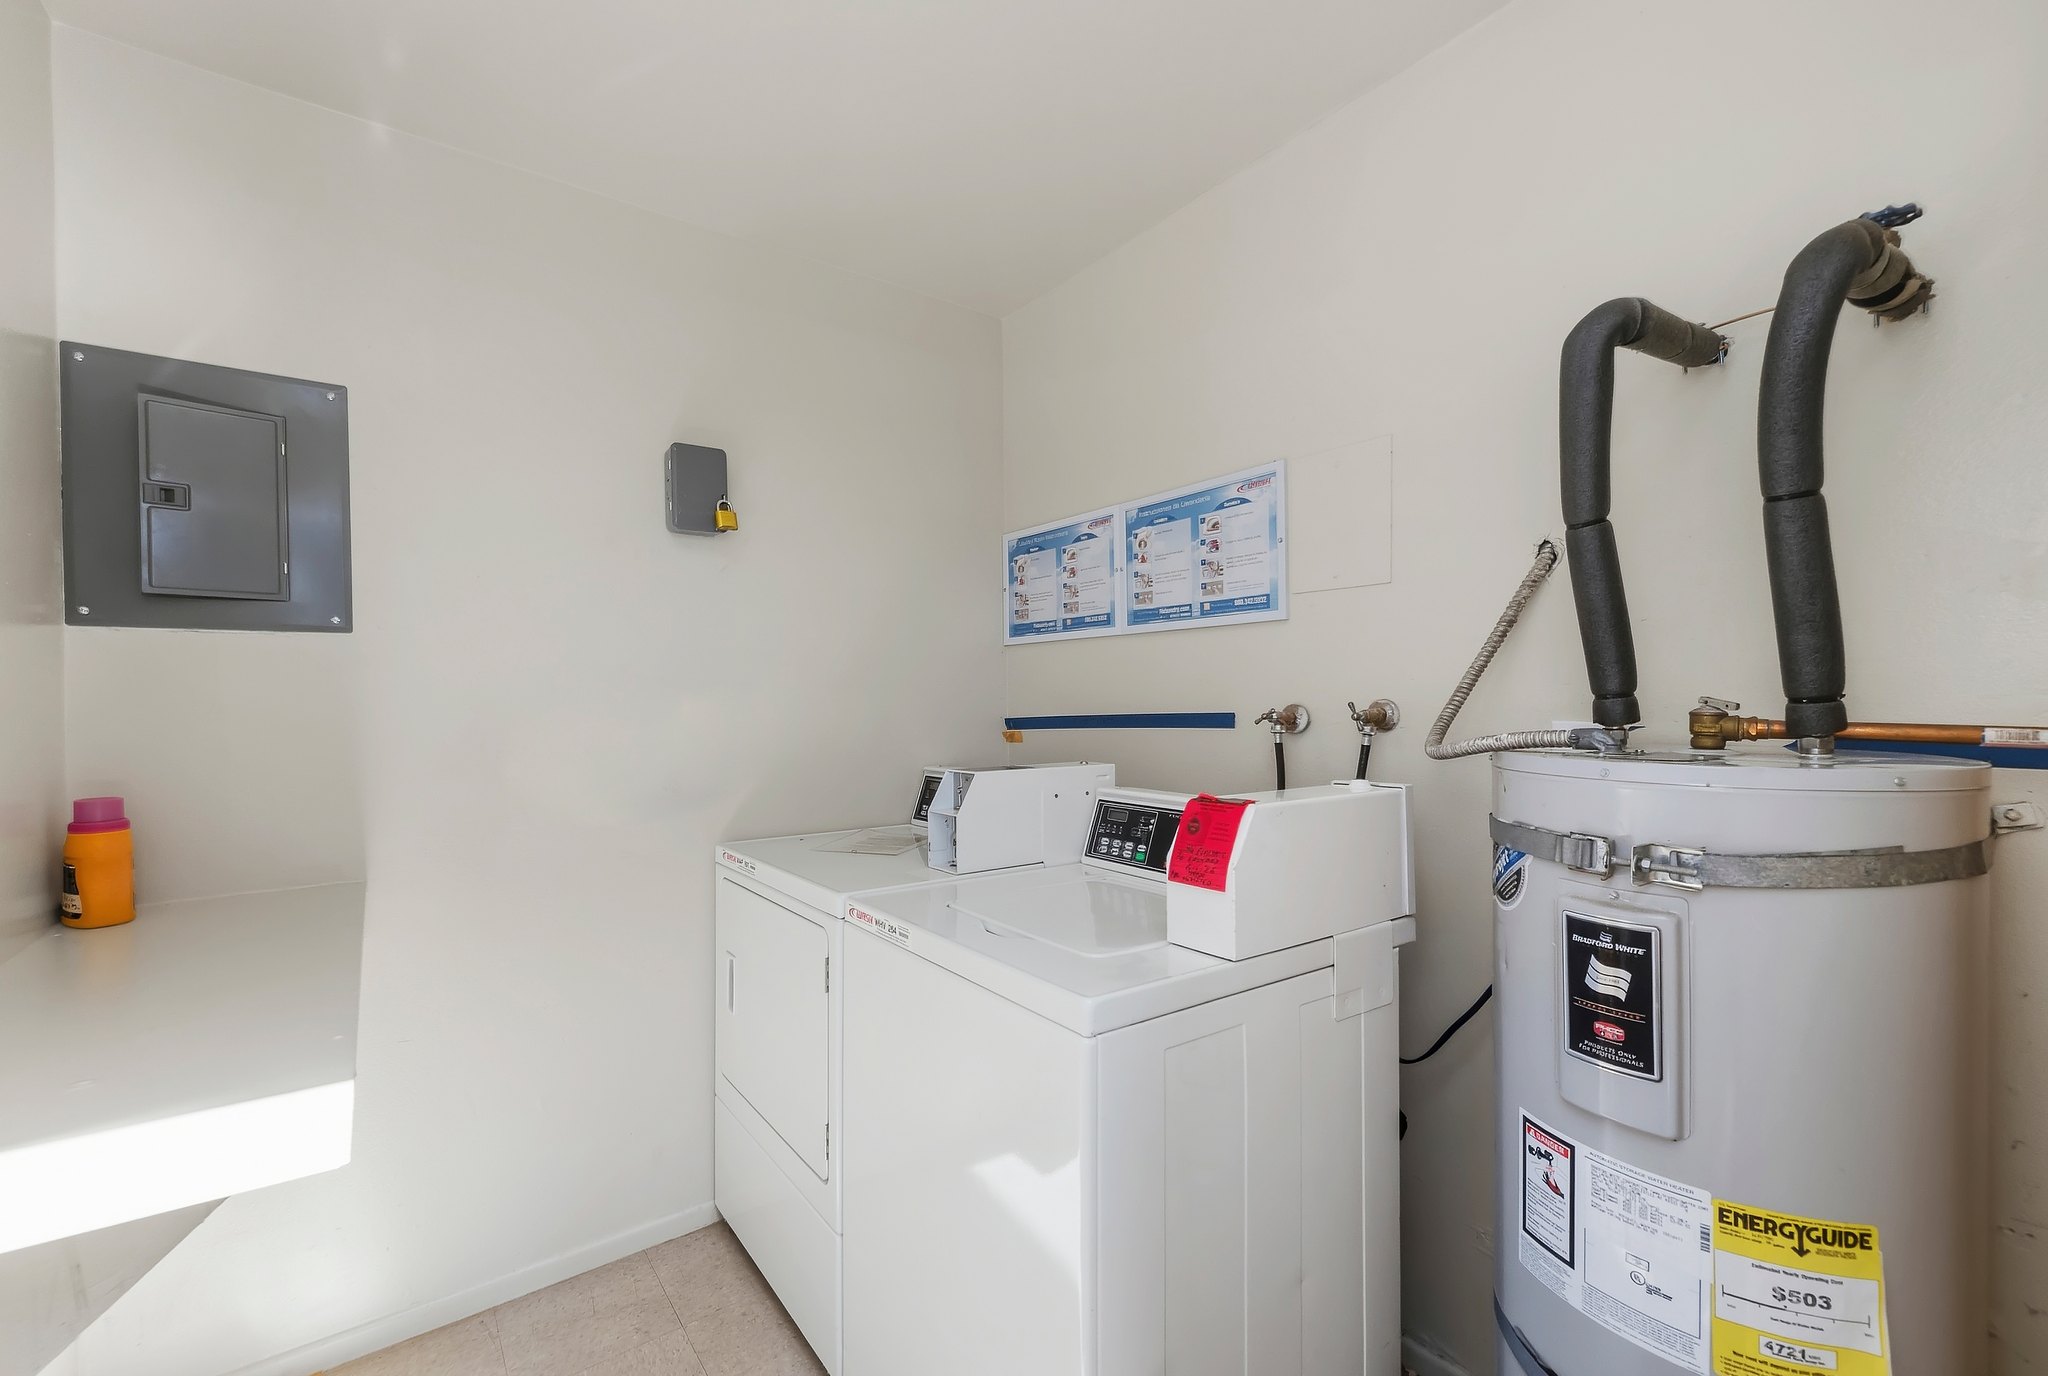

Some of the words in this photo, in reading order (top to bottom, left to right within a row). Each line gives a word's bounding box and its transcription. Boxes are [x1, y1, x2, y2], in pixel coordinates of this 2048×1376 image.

[1572, 933, 1614, 949] BRADFORD
[1615, 943, 1646, 956] WHITE
[1578, 1042, 1591, 1052] FOR
[1591, 1048, 1644, 1068] PROFESSIONALS
[1584, 1040, 1616, 1054] PRODUCTS
[1617, 1050, 1637, 1060] ONLY
[1536, 1133, 1565, 1155] DANGER
[1771, 1285, 1832, 1310] $503
